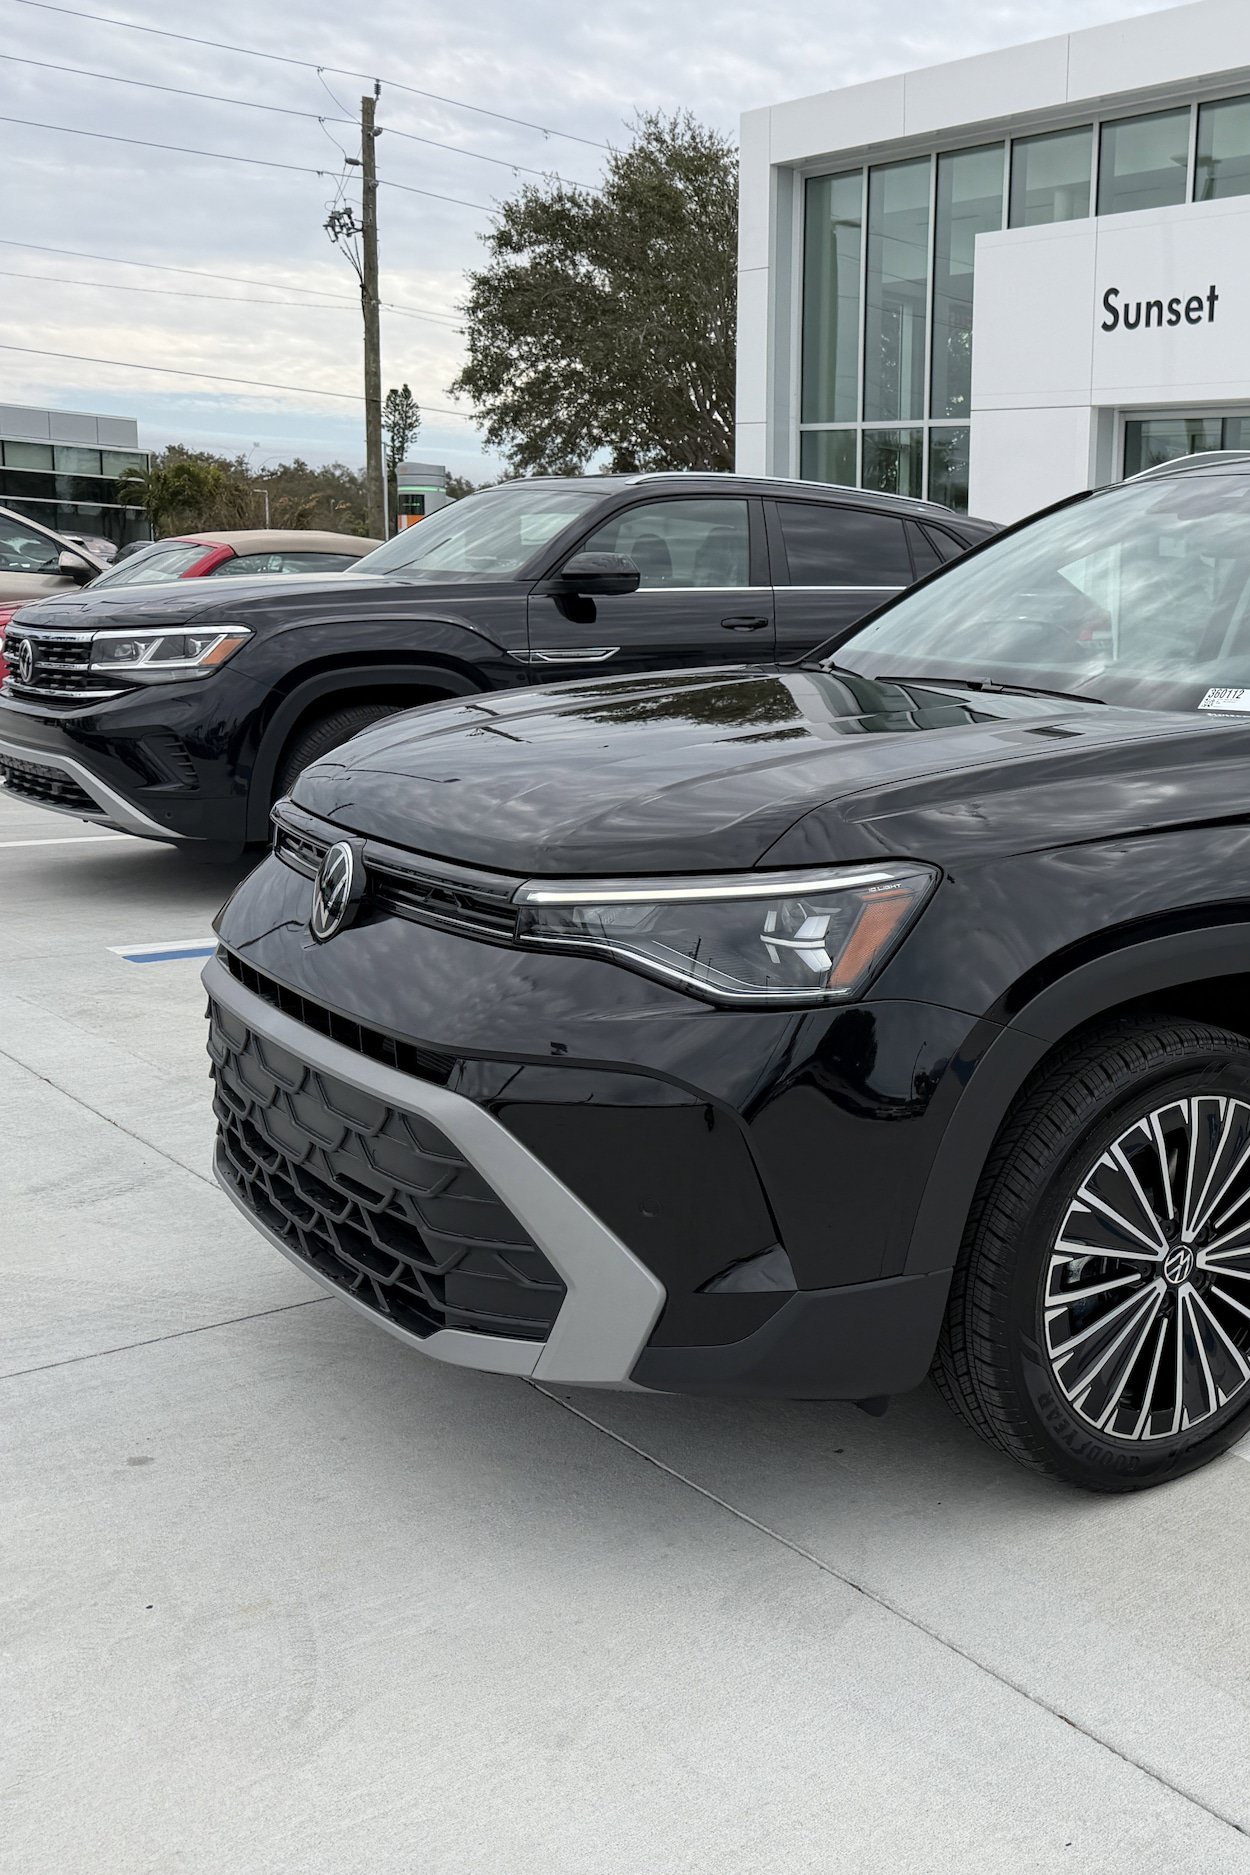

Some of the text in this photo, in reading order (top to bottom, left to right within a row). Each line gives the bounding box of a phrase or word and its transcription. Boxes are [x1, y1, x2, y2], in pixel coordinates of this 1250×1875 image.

[1101, 285, 1219, 332] Sunset
[1208, 688, 1245, 699] 360112
[1037, 1388, 1141, 1473] GOODYEAR
